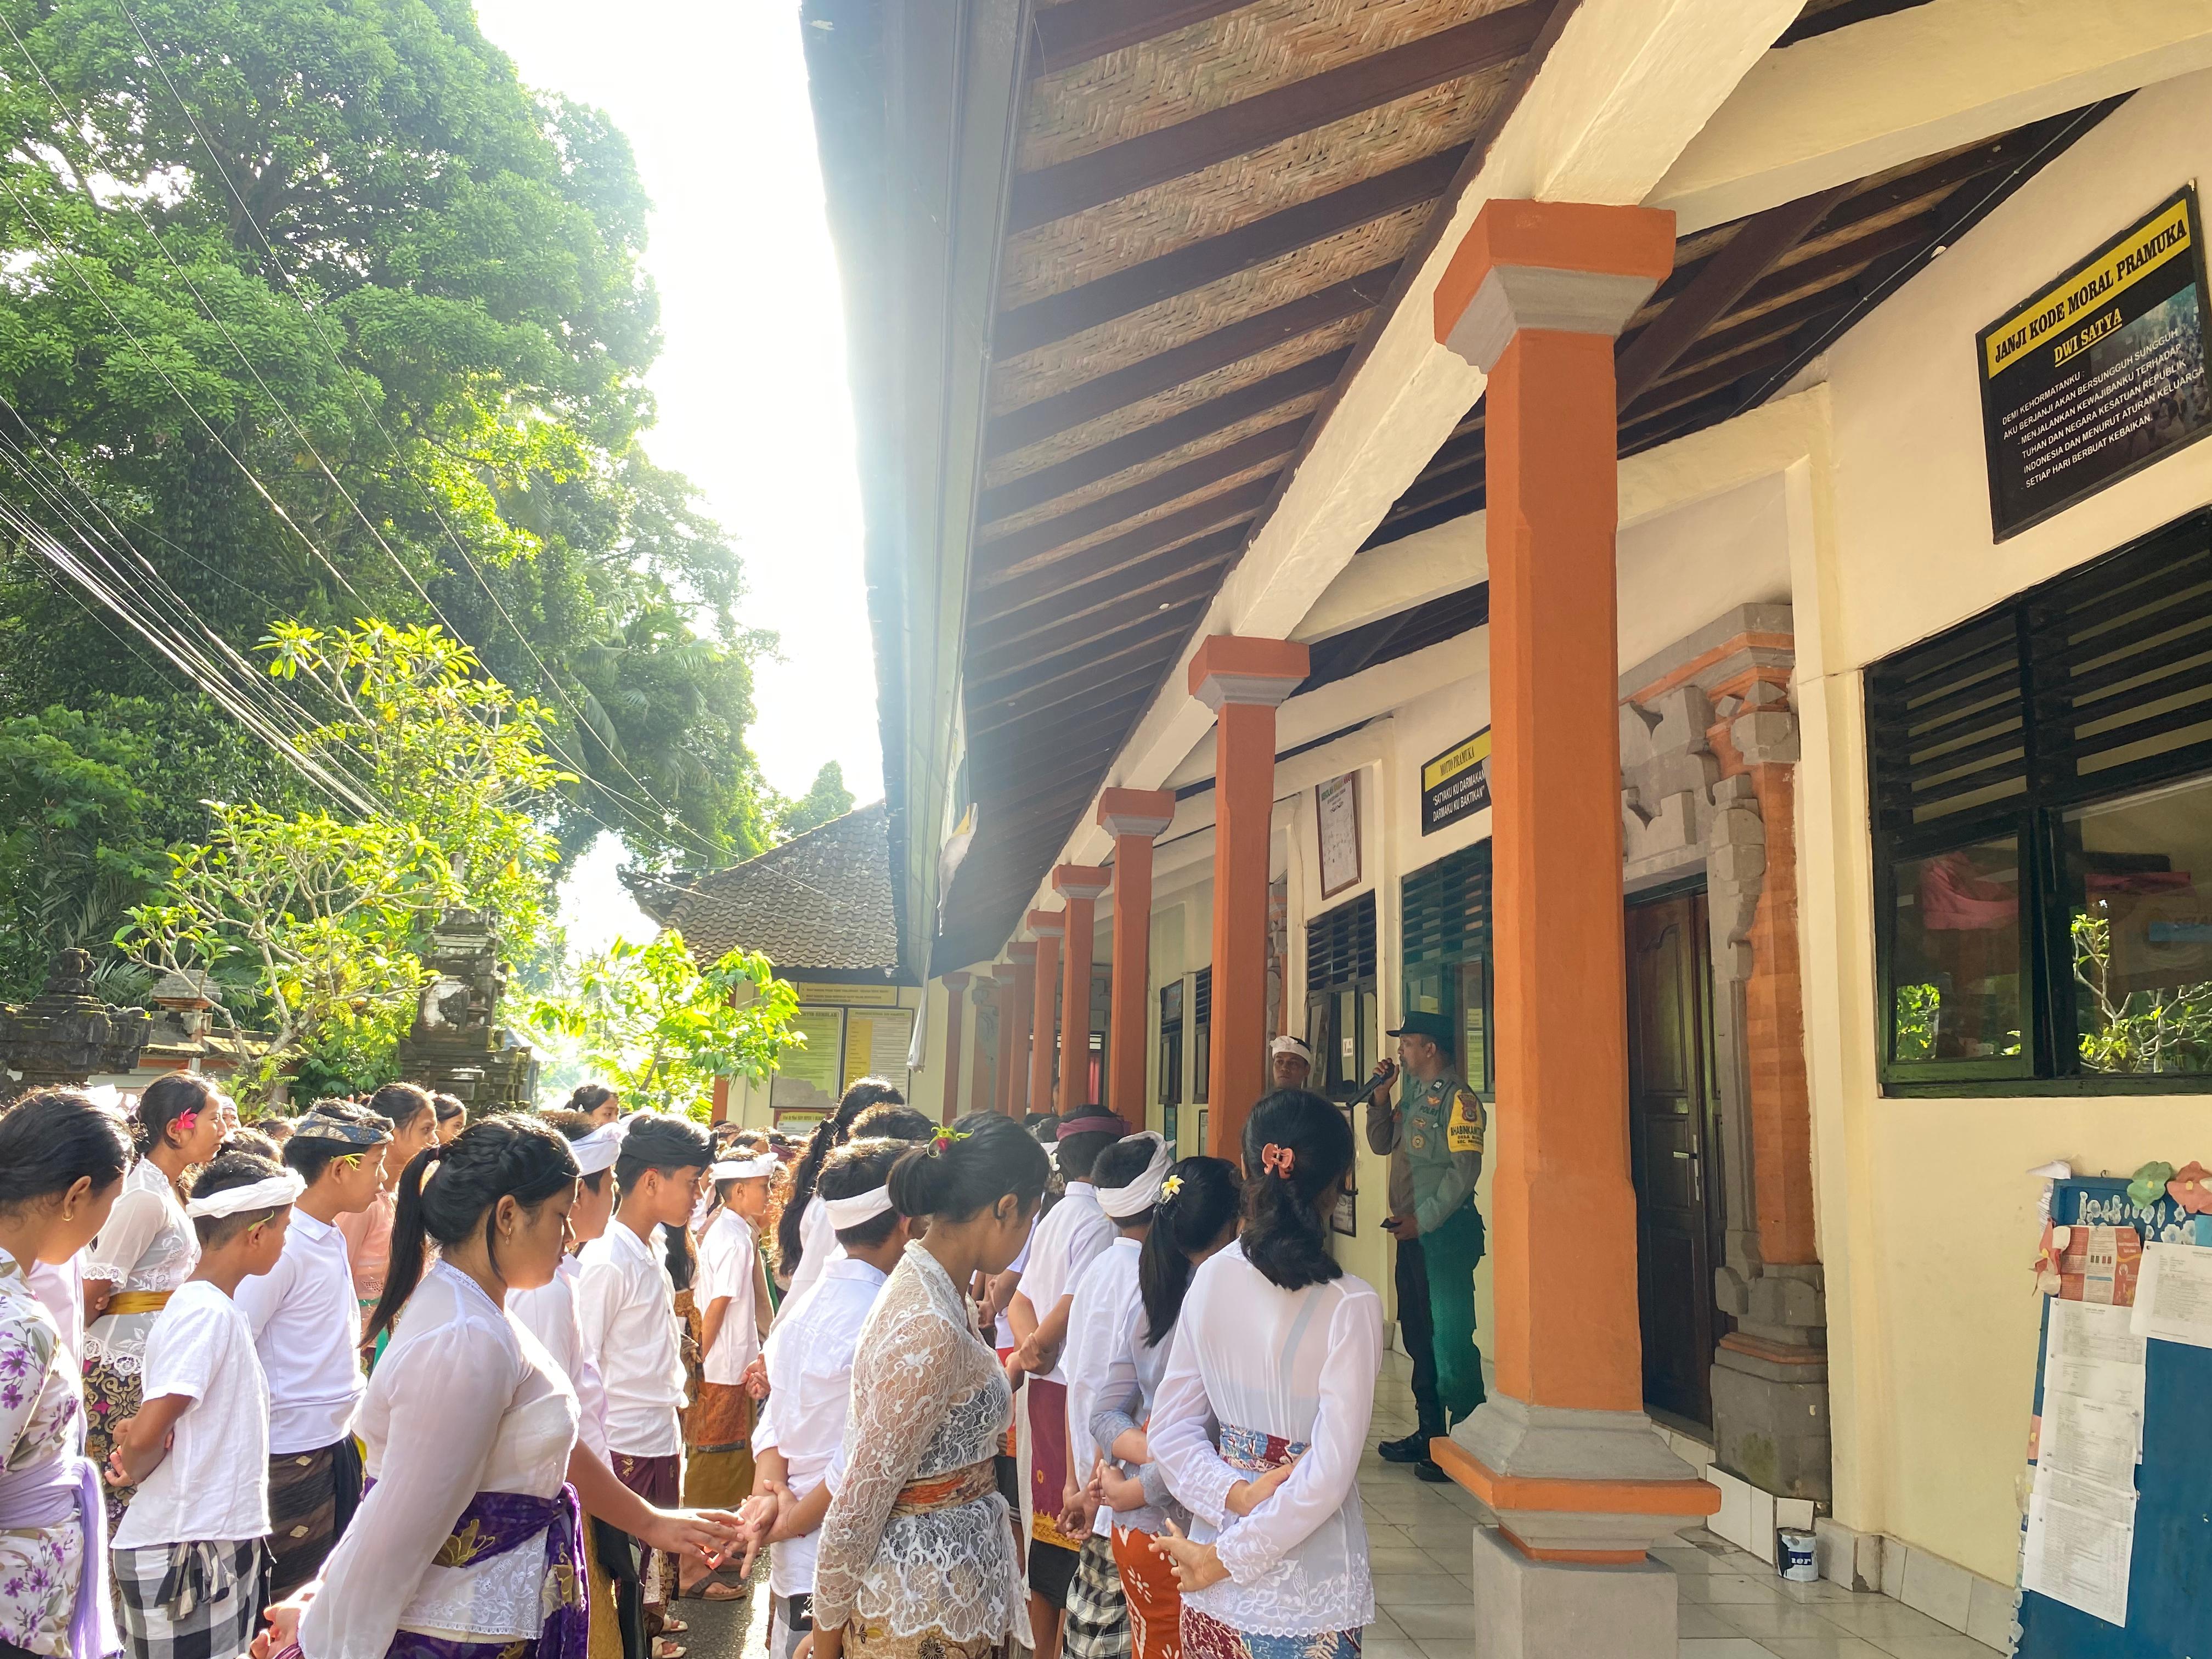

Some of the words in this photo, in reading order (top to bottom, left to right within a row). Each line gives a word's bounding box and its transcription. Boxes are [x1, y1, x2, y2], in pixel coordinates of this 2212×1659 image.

[1995, 331, 2026, 363] JANJI
[2030, 302, 2065, 340] KODE
[2067, 270, 2113, 315] MORAL
[2117, 219, 2186, 282] PRAMUKA
[2054, 336, 2078, 363] DWI
[2081, 308, 2123, 346] SATYA
[2002, 410, 2018, 425] DEMI
[2020, 372, 2081, 415] KEHORMATANKU
[2004, 426, 2018, 439] AKU
[2019, 406, 2053, 430] BERJANJI
[2055, 394, 2076, 414] AKAN
[2078, 356, 2133, 396] BERSUNGGUH
[2135, 329, 2177, 360] SUNGGUH
[2021, 409, 2076, 445] MENJALANKAN
[2077, 374, 2134, 413] KEWAJIBANKU
[2135, 344, 2181, 377] TERHADAP
[2022, 441, 2047, 459] TUHAN
[2049, 431, 2064, 445] DAN
[2066, 411, 2097, 437] NEGARA
[2098, 385, 2141, 415] KESATUAN
[2142, 359, 2186, 391] REPUBLIK
[2024, 447, 2063, 473] INDONESIA
[2065, 438, 2080, 452] DAN
[2083, 414, 2120, 443] MENURUT
[2122, 394, 2155, 420] ATURAN
[2157, 366, 2204, 399] KELUARGA
[2026, 470, 2051, 488] SETIAP
[2052, 460, 2070, 474] HARI
[2072, 439, 2107, 465] BERBUAT
[1440, 759, 1453, 776] MOTTO
[1453, 746, 1475, 769] PRAMUKA
[1453, 782, 1459, 795] KU
[1434, 804, 1453, 822] DARMAKU
[1454, 798, 1460, 810] KU
